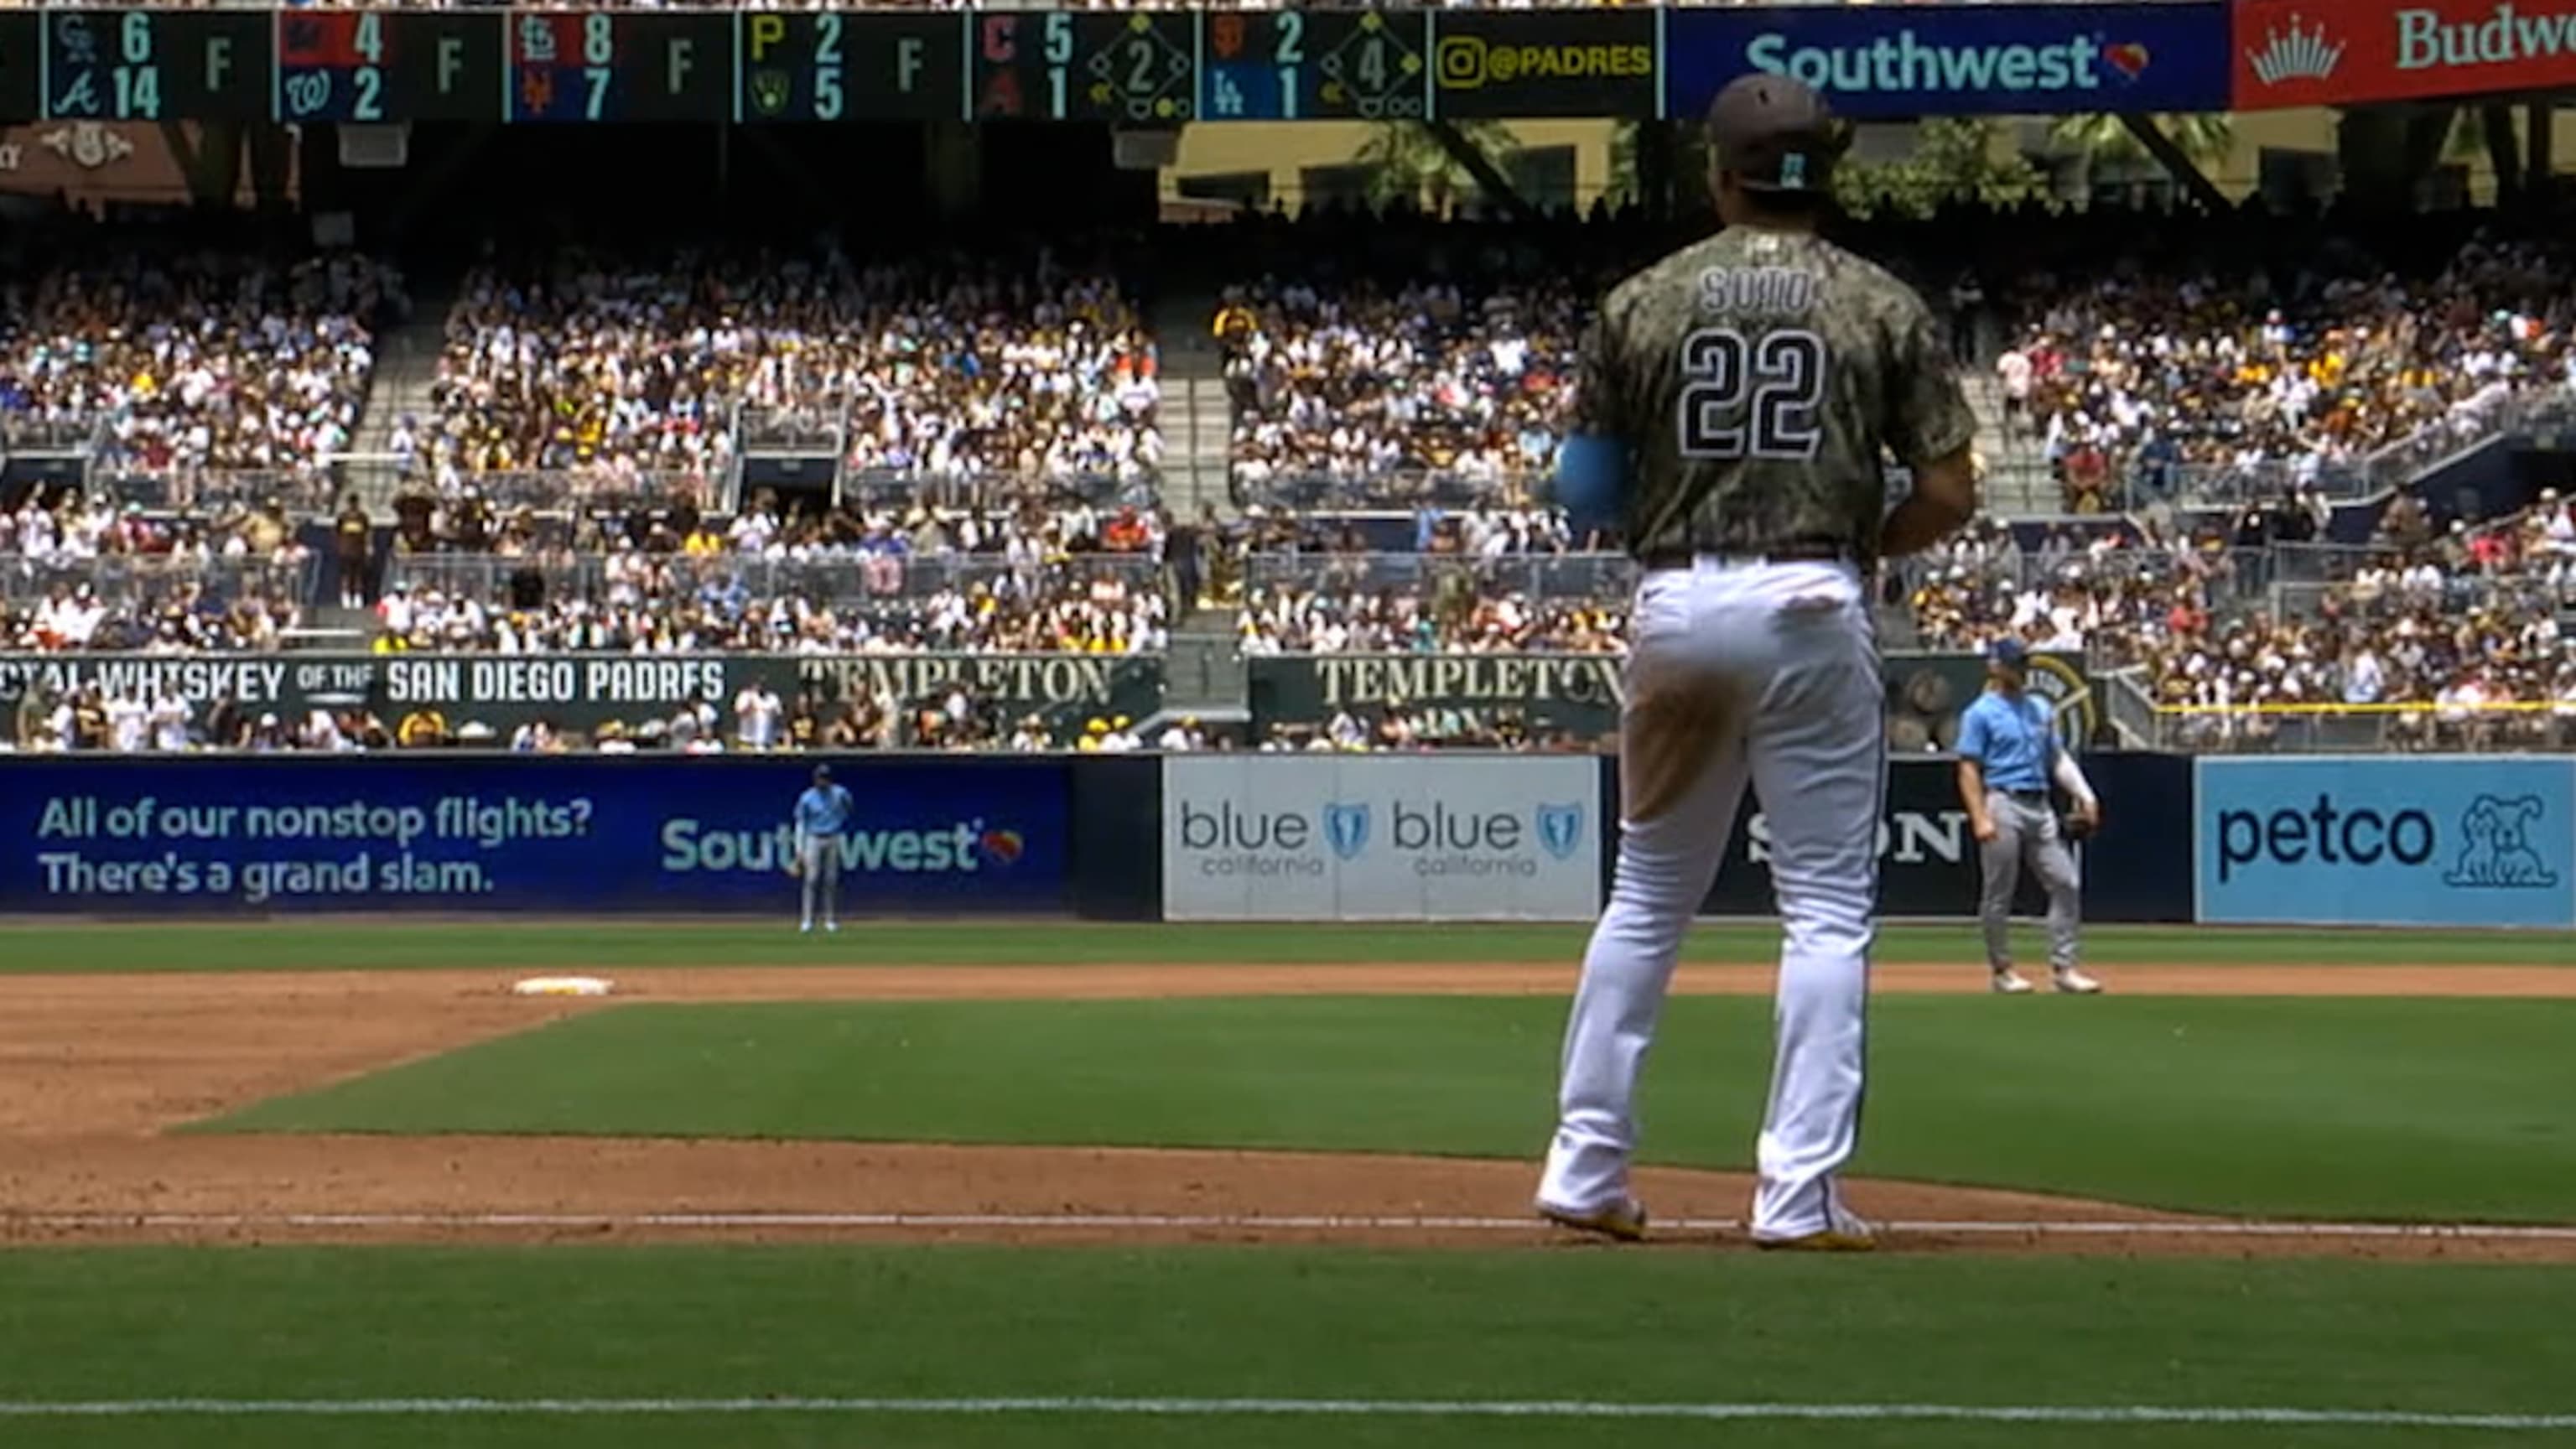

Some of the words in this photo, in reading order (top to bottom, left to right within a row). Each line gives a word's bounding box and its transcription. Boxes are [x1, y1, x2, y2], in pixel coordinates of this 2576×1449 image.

[122, 12, 151, 63] 6
[354, 12, 383, 64] 4
[584, 13, 613, 64] 8
[751, 14, 784, 61] P
[814, 13, 843, 64] 2
[982, 15, 1015, 61] C
[1045, 13, 1072, 64] 5
[1275, 12, 1303, 63] 2
[1488, 45, 1651, 80] @PADRES
[1747, 30, 2099, 91] Southwest
[207, 38, 231, 91] F
[438, 39, 462, 93] F
[669, 39, 693, 94] F
[897, 39, 921, 91] F
[1127, 40, 1154, 91] 2
[1358, 39, 1385, 90] 4
[112, 66, 160, 119] 14
[286, 68, 330, 116] W
[354, 67, 383, 120] 2
[584, 67, 612, 121] 7
[814, 67, 843, 121] 5
[1048, 67, 1067, 119] 1
[1279, 67, 1297, 118] 1
[1698, 266, 1813, 314] SOTO
[1679, 328, 1826, 460] 22
[97, 661, 283, 702] WHISKEY
[297, 665, 328, 692] OF
[332, 665, 374, 690] THE
[387, 661, 460, 701] SAN
[472, 661, 574, 701] DIEGO
[588, 661, 724, 701] PADRES
[39, 797, 95, 837] All
[106, 797, 156, 837] of
[160, 804, 236, 837] our
[247, 800, 424, 848] nonstop
[435, 797, 591, 848] flights?
[661, 818, 978, 870] Soutwest
[1181, 801, 1309, 850] blue
[1393, 801, 1522, 850] blue
[2218, 793, 2436, 883] petco
[39, 852, 199, 892] There's
[207, 860, 231, 892] a
[243, 852, 369, 902] grand
[380, 852, 493, 892] slam.
[1202, 854, 1325, 877] california
[1413, 854, 1537, 877] california
